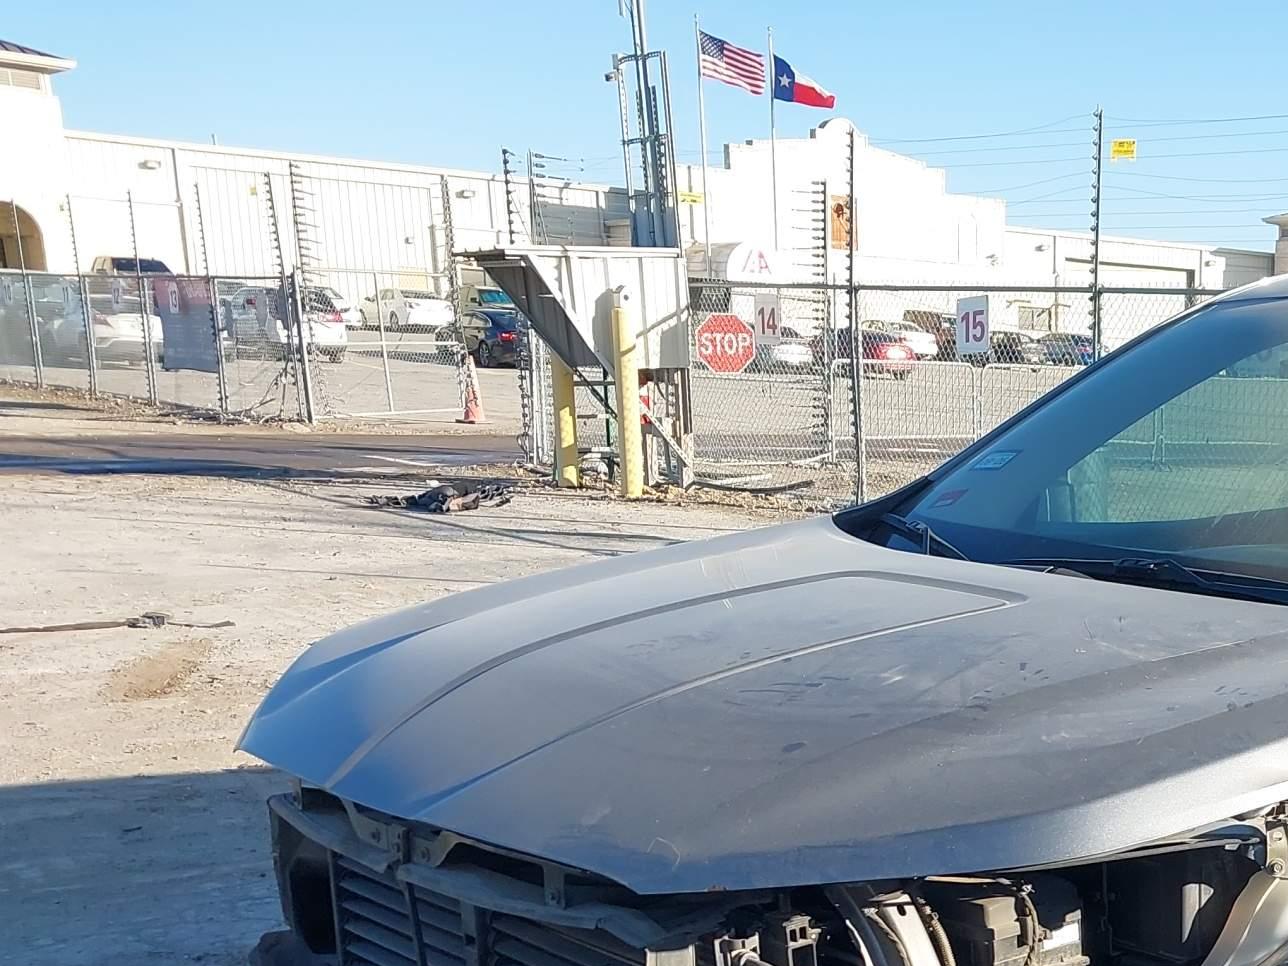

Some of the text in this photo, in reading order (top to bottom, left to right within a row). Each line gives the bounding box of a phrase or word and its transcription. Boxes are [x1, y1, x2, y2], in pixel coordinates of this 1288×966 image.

[170, 289, 178, 309] 13
[758, 306, 777, 336] 14
[961, 309, 985, 343] 15
[700, 332, 751, 355] STOP
